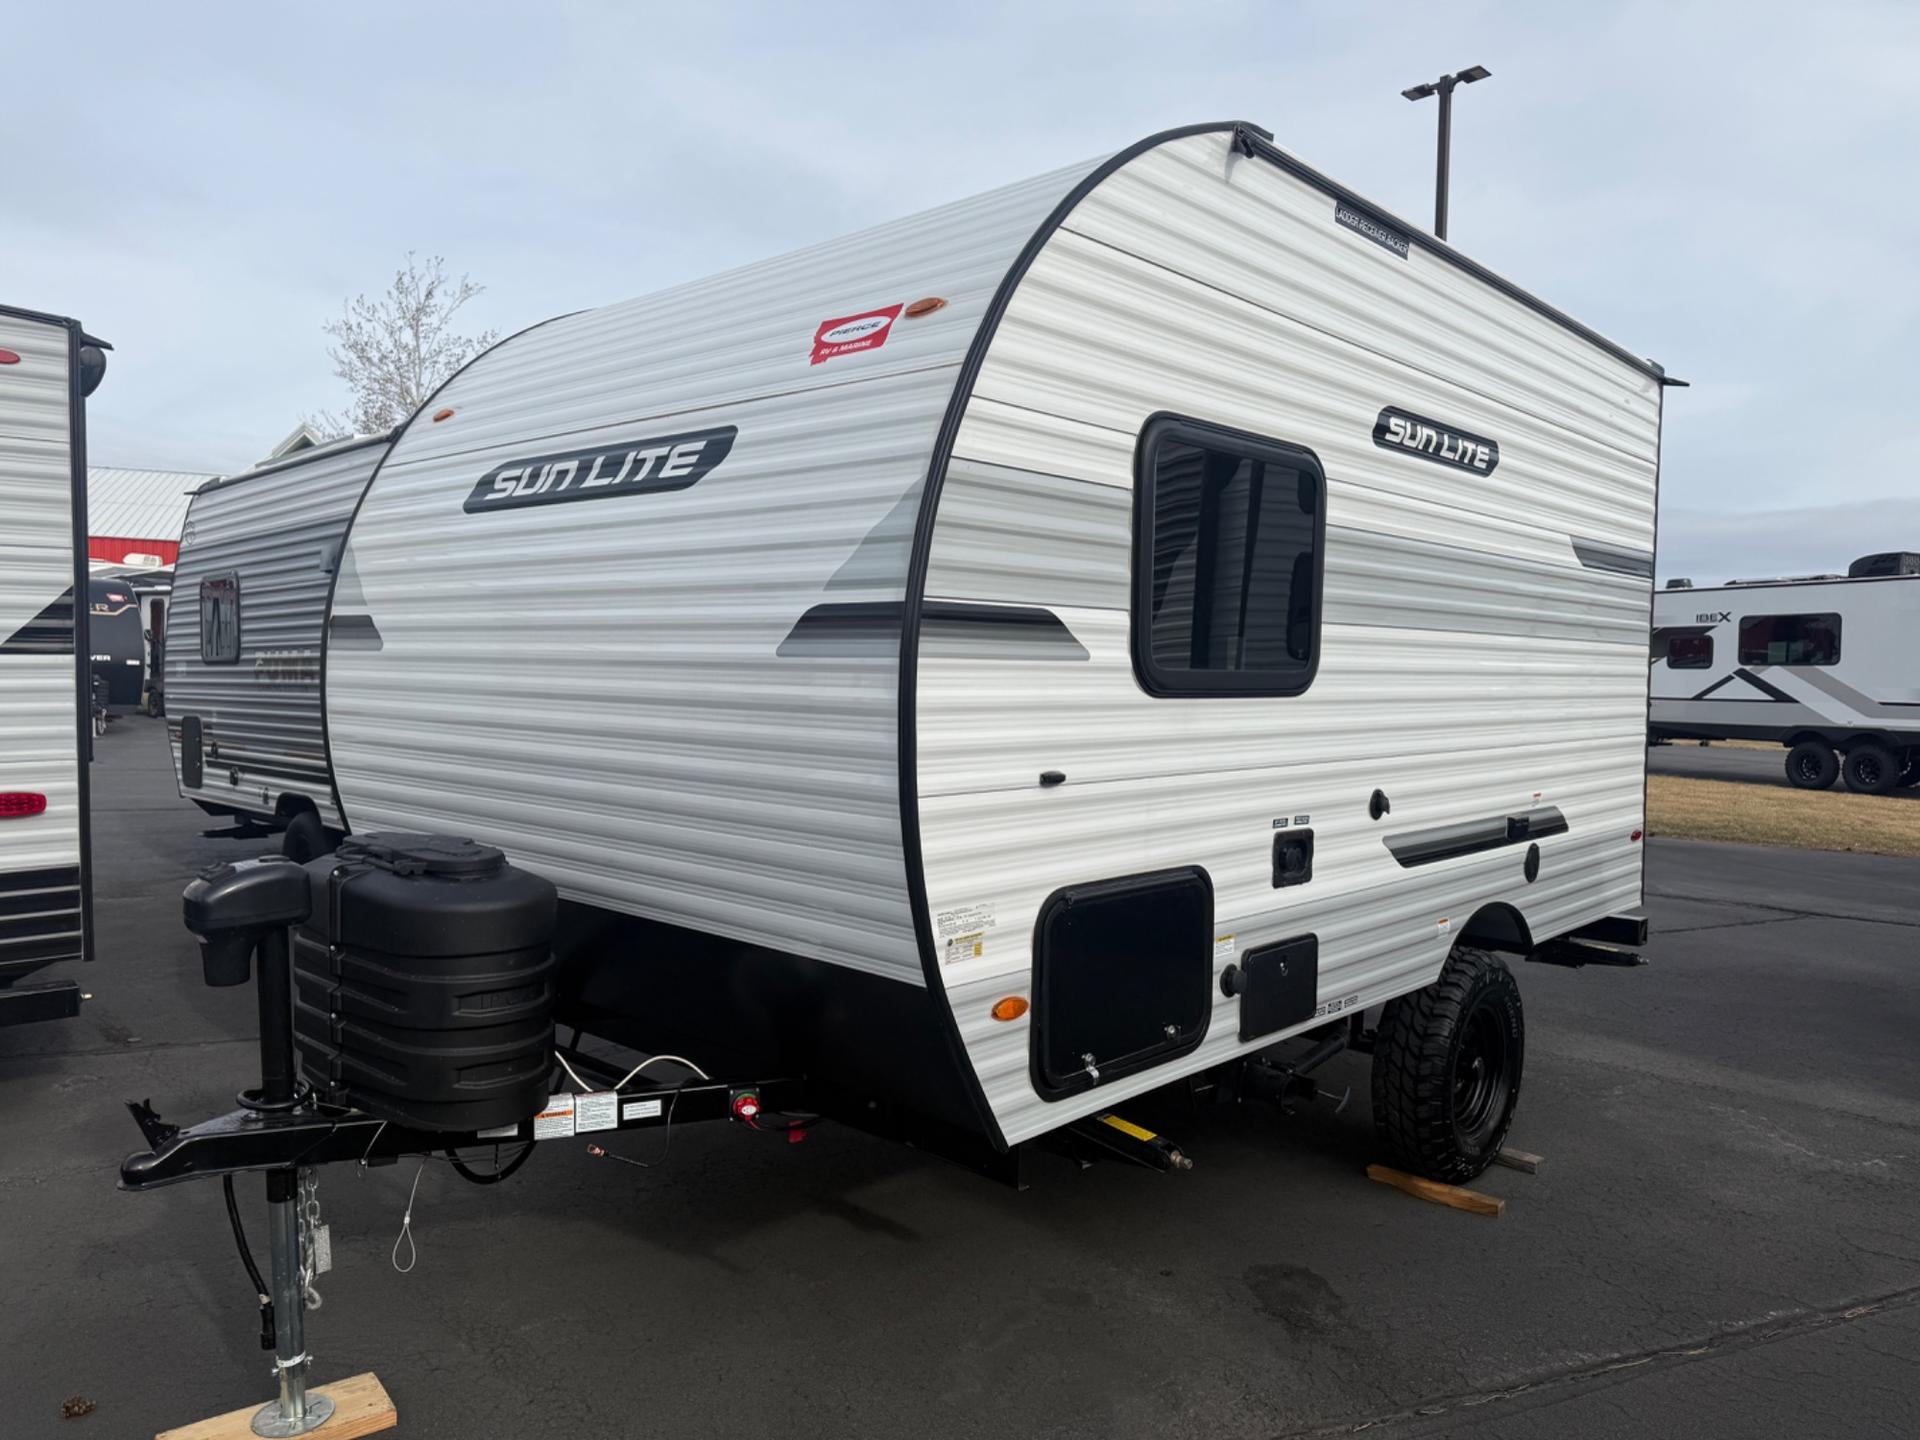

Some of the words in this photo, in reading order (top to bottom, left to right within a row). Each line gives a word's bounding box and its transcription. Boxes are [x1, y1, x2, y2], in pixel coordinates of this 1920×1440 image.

[1335, 207, 1359, 228] LADDER
[829, 320, 881, 337] PIERCE
[839, 340, 873, 352] MARINE
[1384, 416, 1437, 453] SUN
[1440, 433, 1490, 469] LITE
[483, 461, 580, 500] SUN
[584, 439, 708, 487] LITE
[1696, 611, 1732, 623] IBEX
